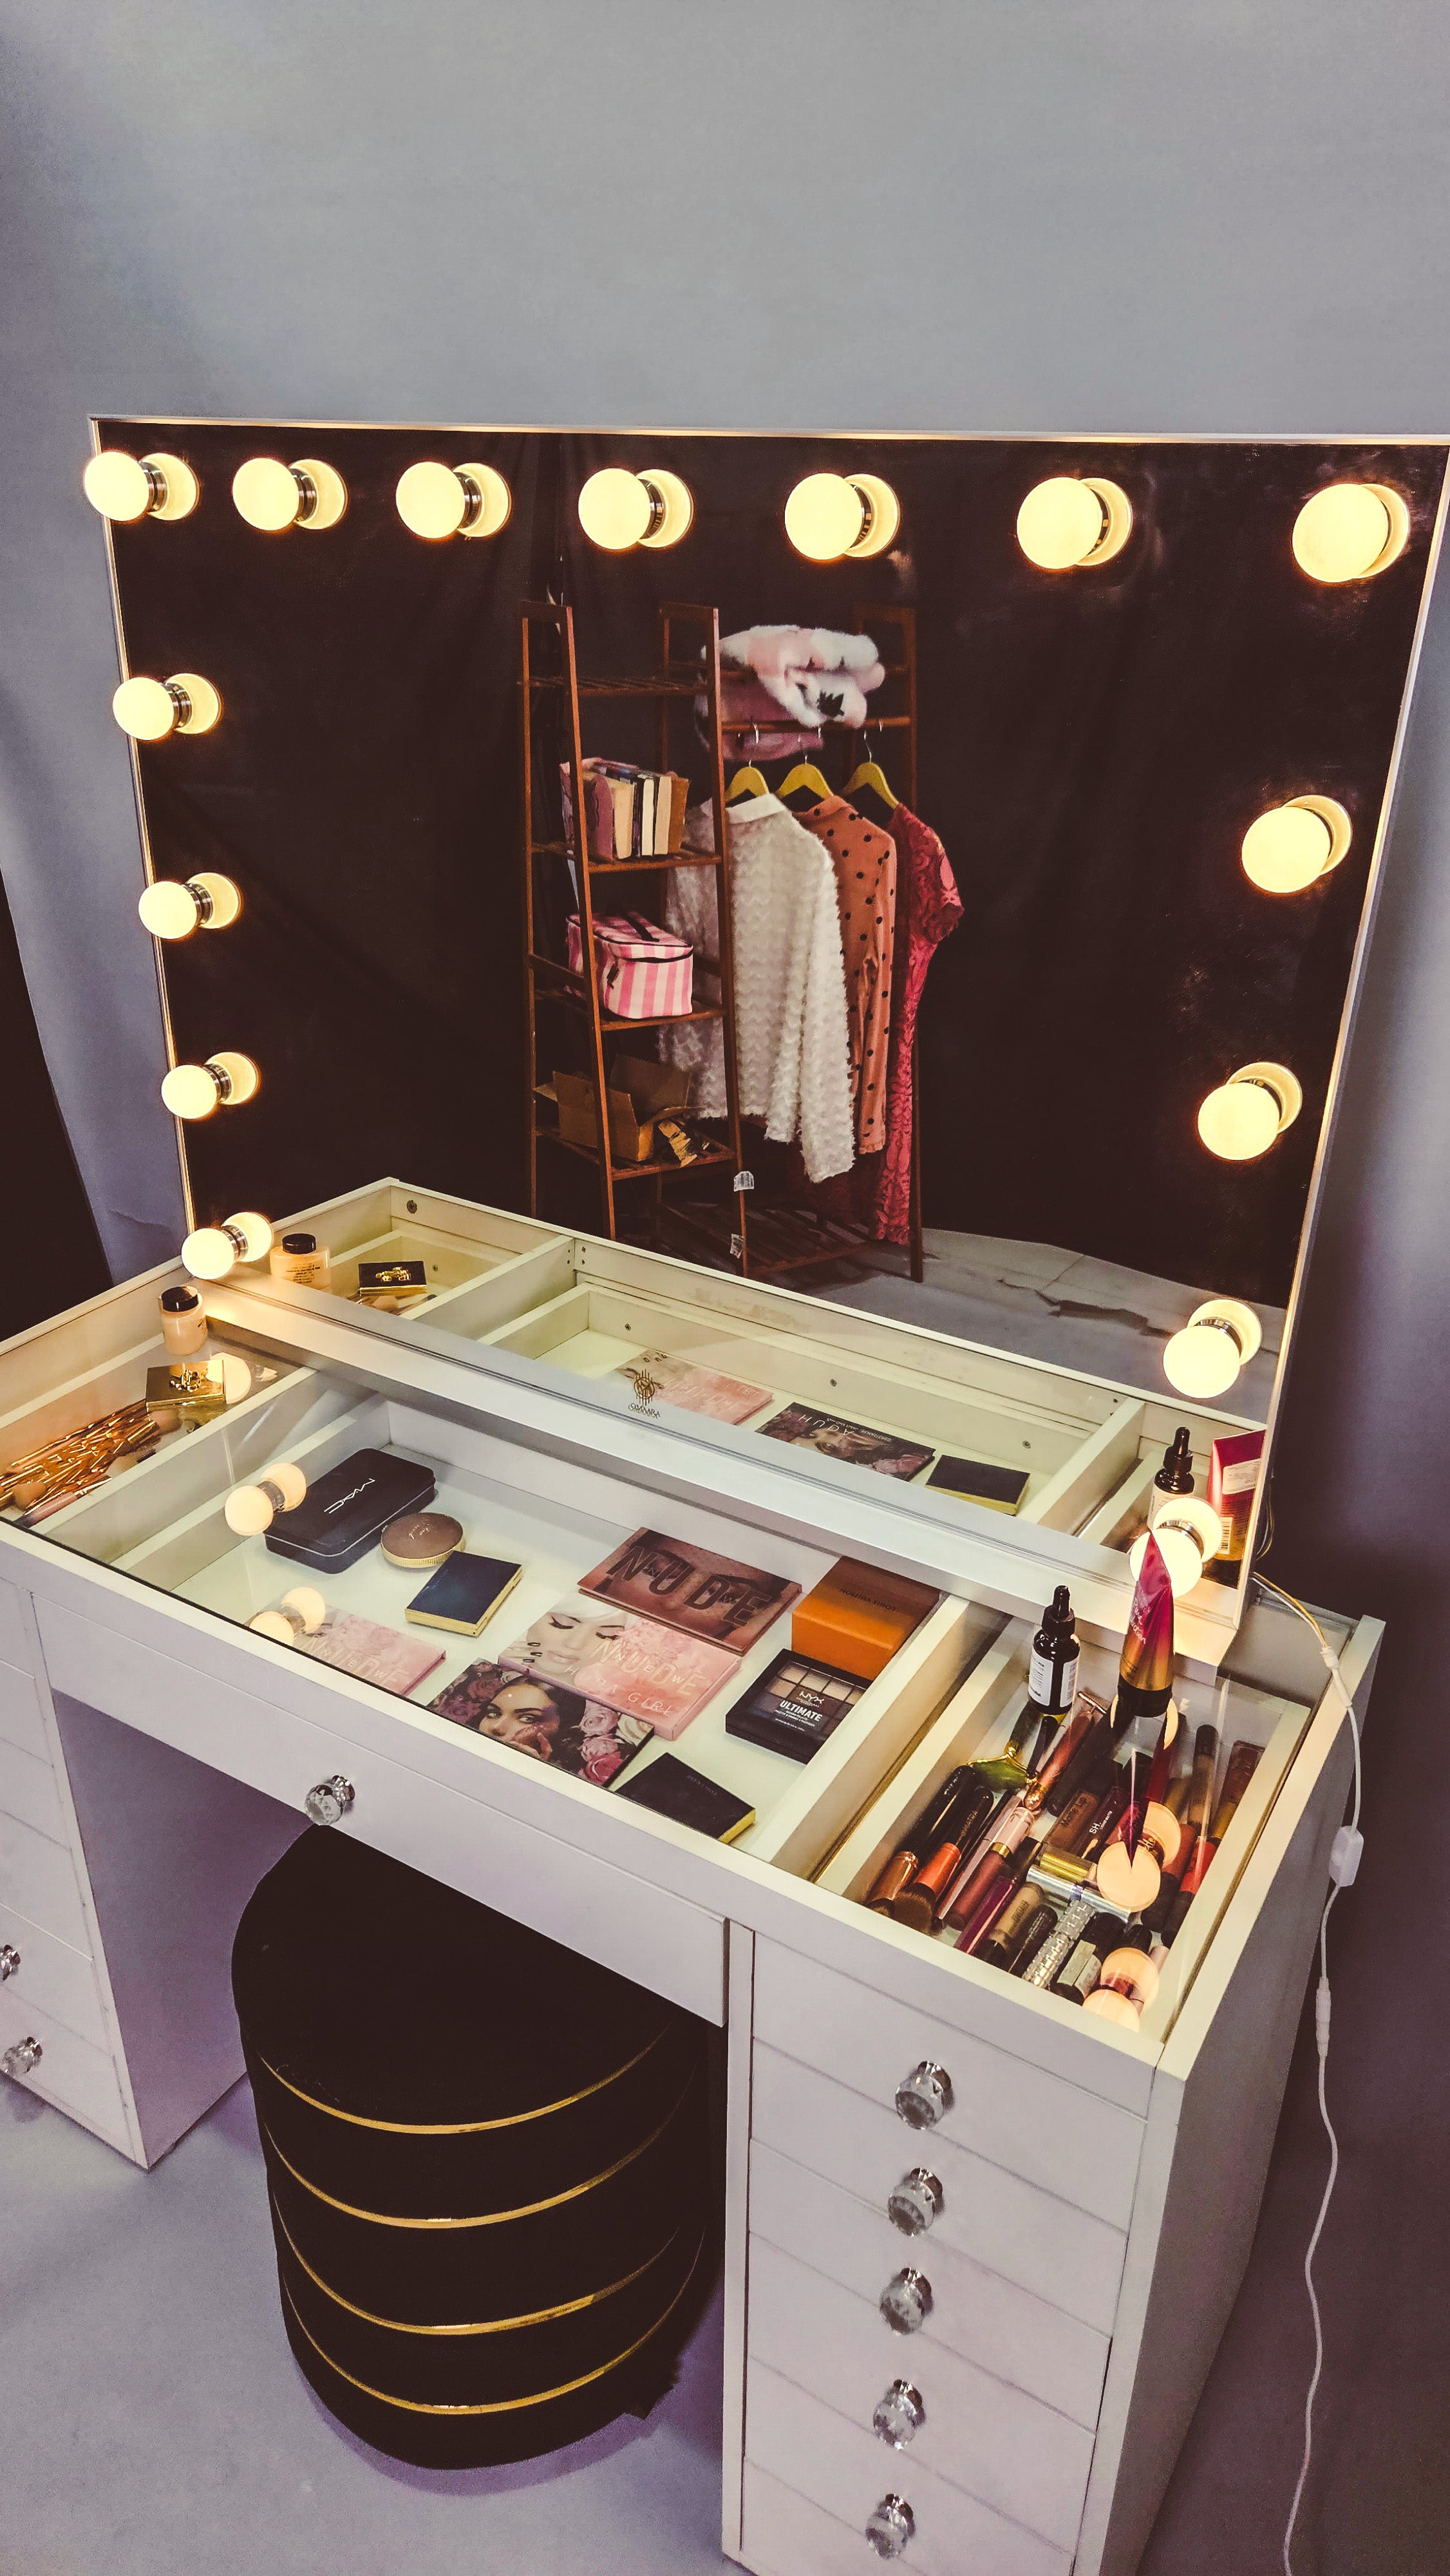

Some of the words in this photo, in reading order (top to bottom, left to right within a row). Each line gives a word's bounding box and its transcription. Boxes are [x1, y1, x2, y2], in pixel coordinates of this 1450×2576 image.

[606, 1546, 771, 1625] NUDE
[589, 1637, 708, 1697] NUDE
[627, 1692, 675, 1718] GIRL
[798, 1690, 824, 1706] NYX
[779, 1700, 823, 1723] ULTIMATE
